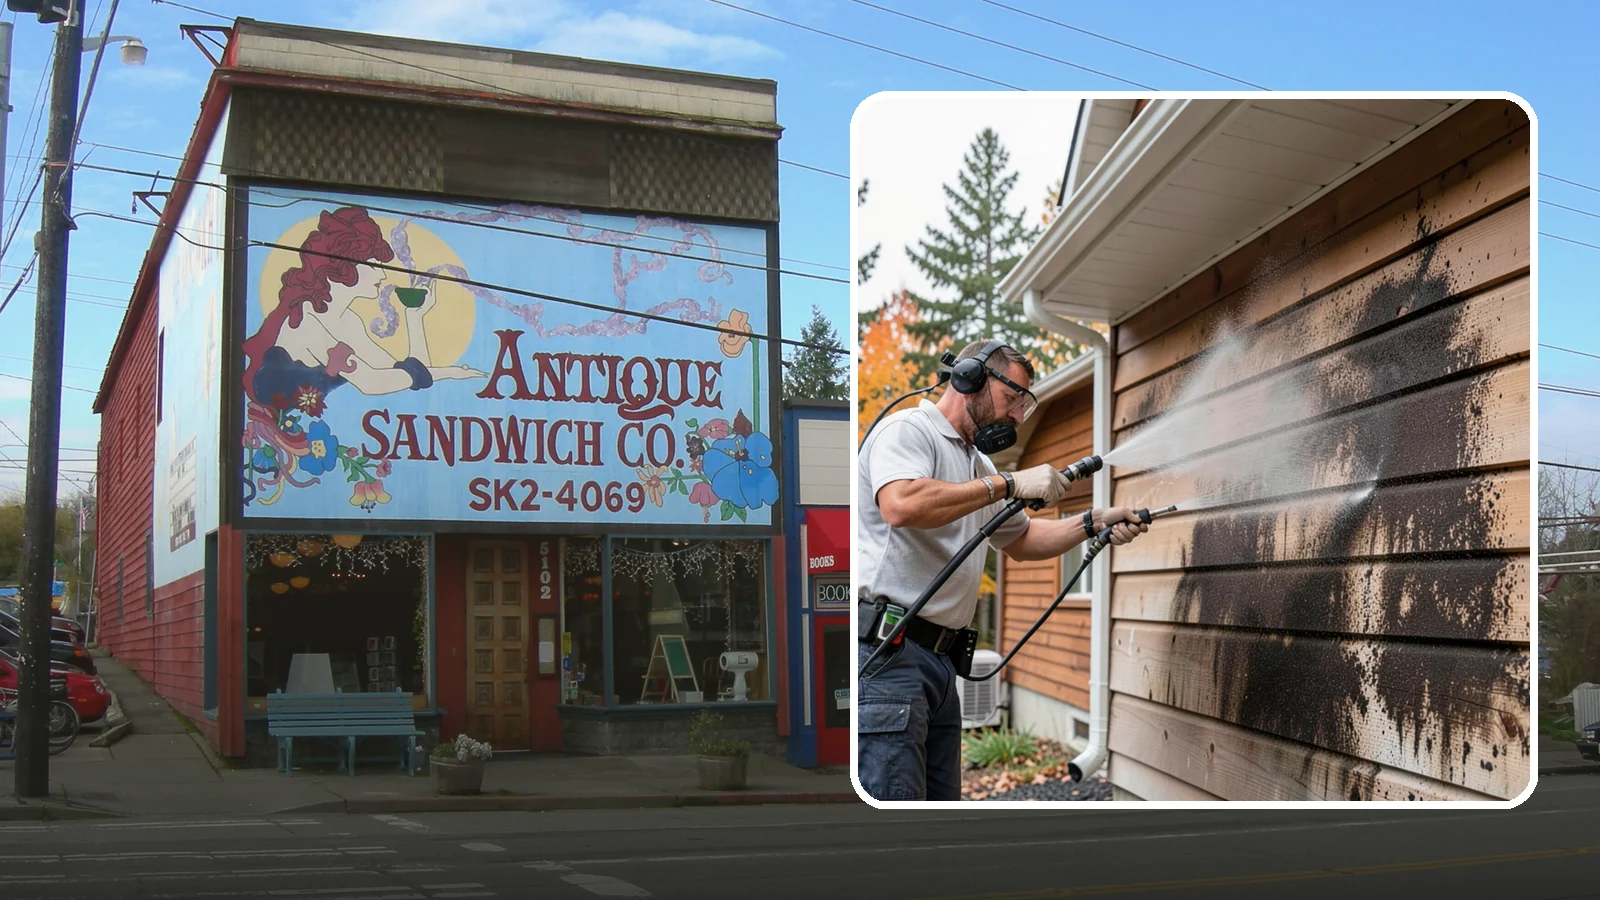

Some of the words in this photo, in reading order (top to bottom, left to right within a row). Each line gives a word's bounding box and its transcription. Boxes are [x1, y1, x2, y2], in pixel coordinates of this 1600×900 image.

[475, 328, 724, 420] ANTIQUE
[361, 408, 604, 467] SANDWICH
[617, 421, 685, 469] CO.
[468, 477, 646, 512] SK2-4069
[540, 541, 552, 600] 5102
[809, 555, 834, 569] BOOKS
